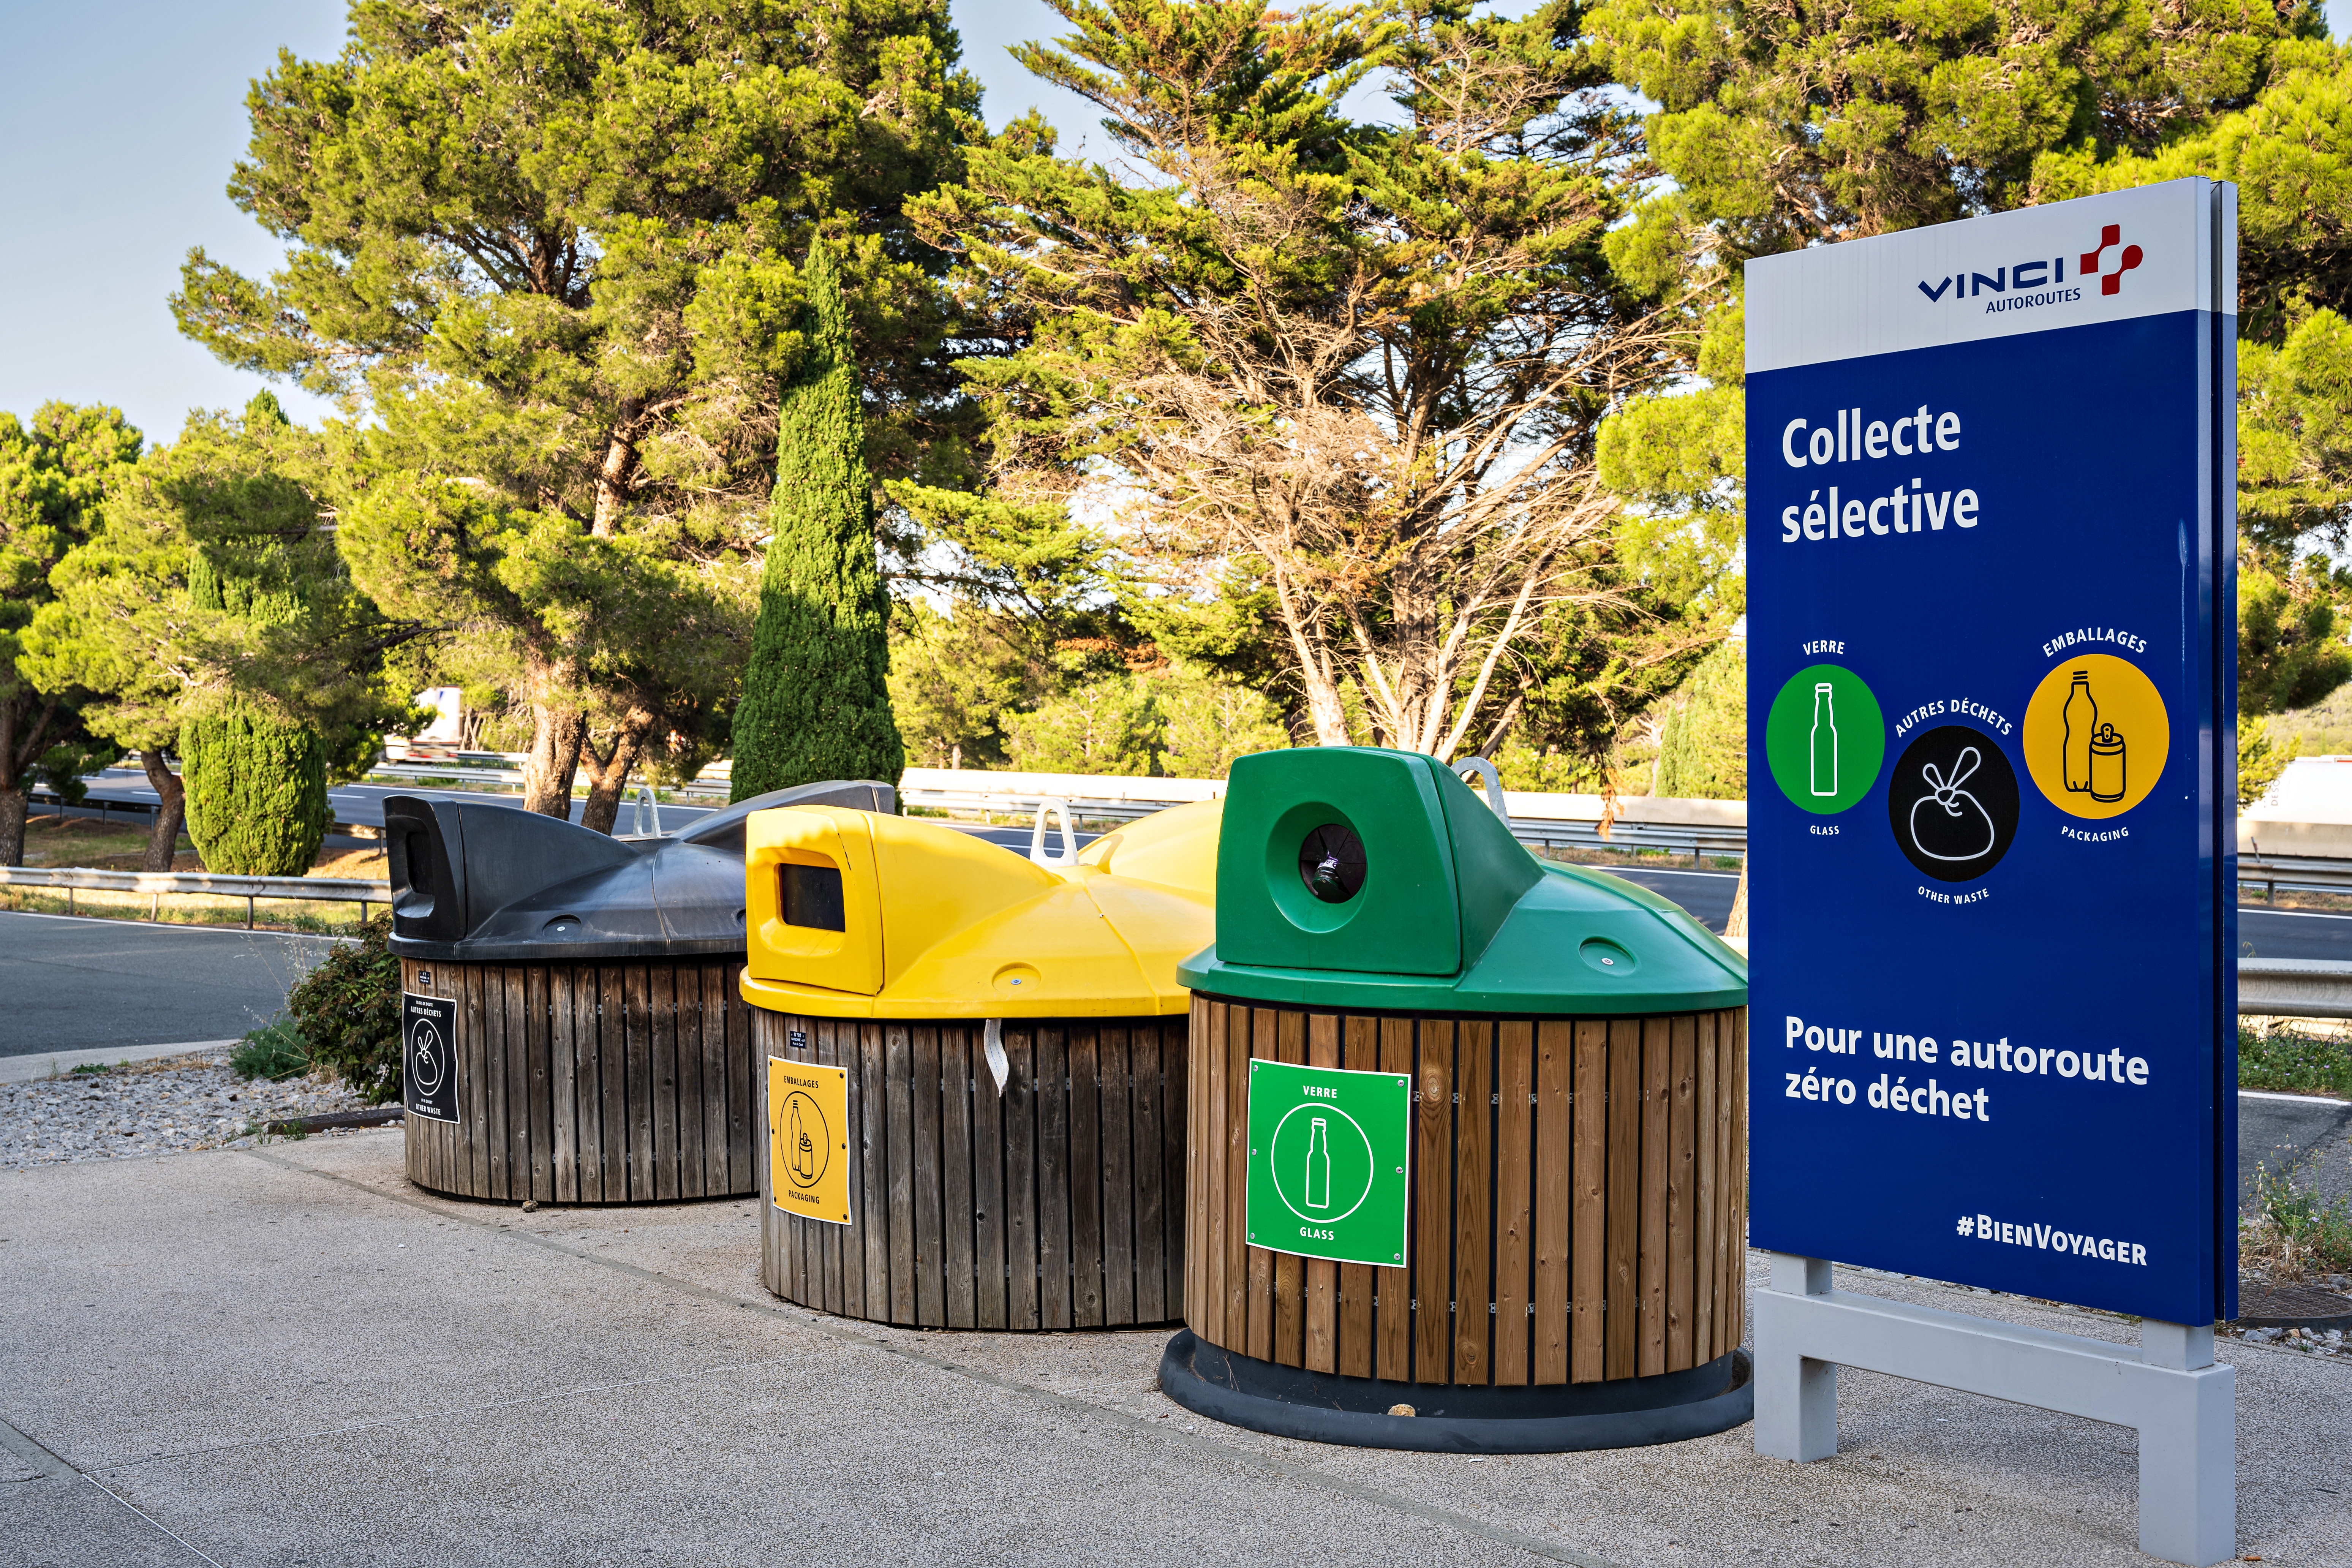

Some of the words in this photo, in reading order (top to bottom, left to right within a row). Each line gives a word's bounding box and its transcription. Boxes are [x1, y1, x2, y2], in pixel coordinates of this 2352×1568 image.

[1918, 257, 2063, 303] VINCI
[1985, 288, 2081, 314] AUTOROUTES
[1782, 404, 1960, 468] Collecte
[1782, 477, 1979, 543] sélective
[1802, 640, 1845, 655] VERRE
[2042, 627, 2147, 657] EMBALLAGES
[1896, 700, 1944, 738] AUTRES
[1951, 697, 2012, 735] DÉCHETS
[1810, 825, 1839, 835] GLASS
[2061, 825, 2129, 842] PACKAGING
[1918, 886, 1950, 904] OTHER
[1954, 888, 1989, 904] WASTE
[411, 1006, 423, 1014] AUTRES
[424, 1008, 441, 1017] DÉCHETS
[1786, 1016, 1862, 1055] Pour
[1873, 1032, 1938, 1063] une
[1951, 1037, 2149, 1085] autoroute
[784, 1075, 819, 1089] EMBALLAGES
[1303, 1085, 1337, 1099] VERRE
[1786, 1066, 1856, 1105] zéro
[1868, 1073, 1989, 1122] déchet
[416, 1103, 426, 1112] OTHER
[427, 1106, 441, 1115] WASTE
[789, 1190, 819, 1204] PACKAGING
[1299, 1227, 1334, 1241] GLASS
